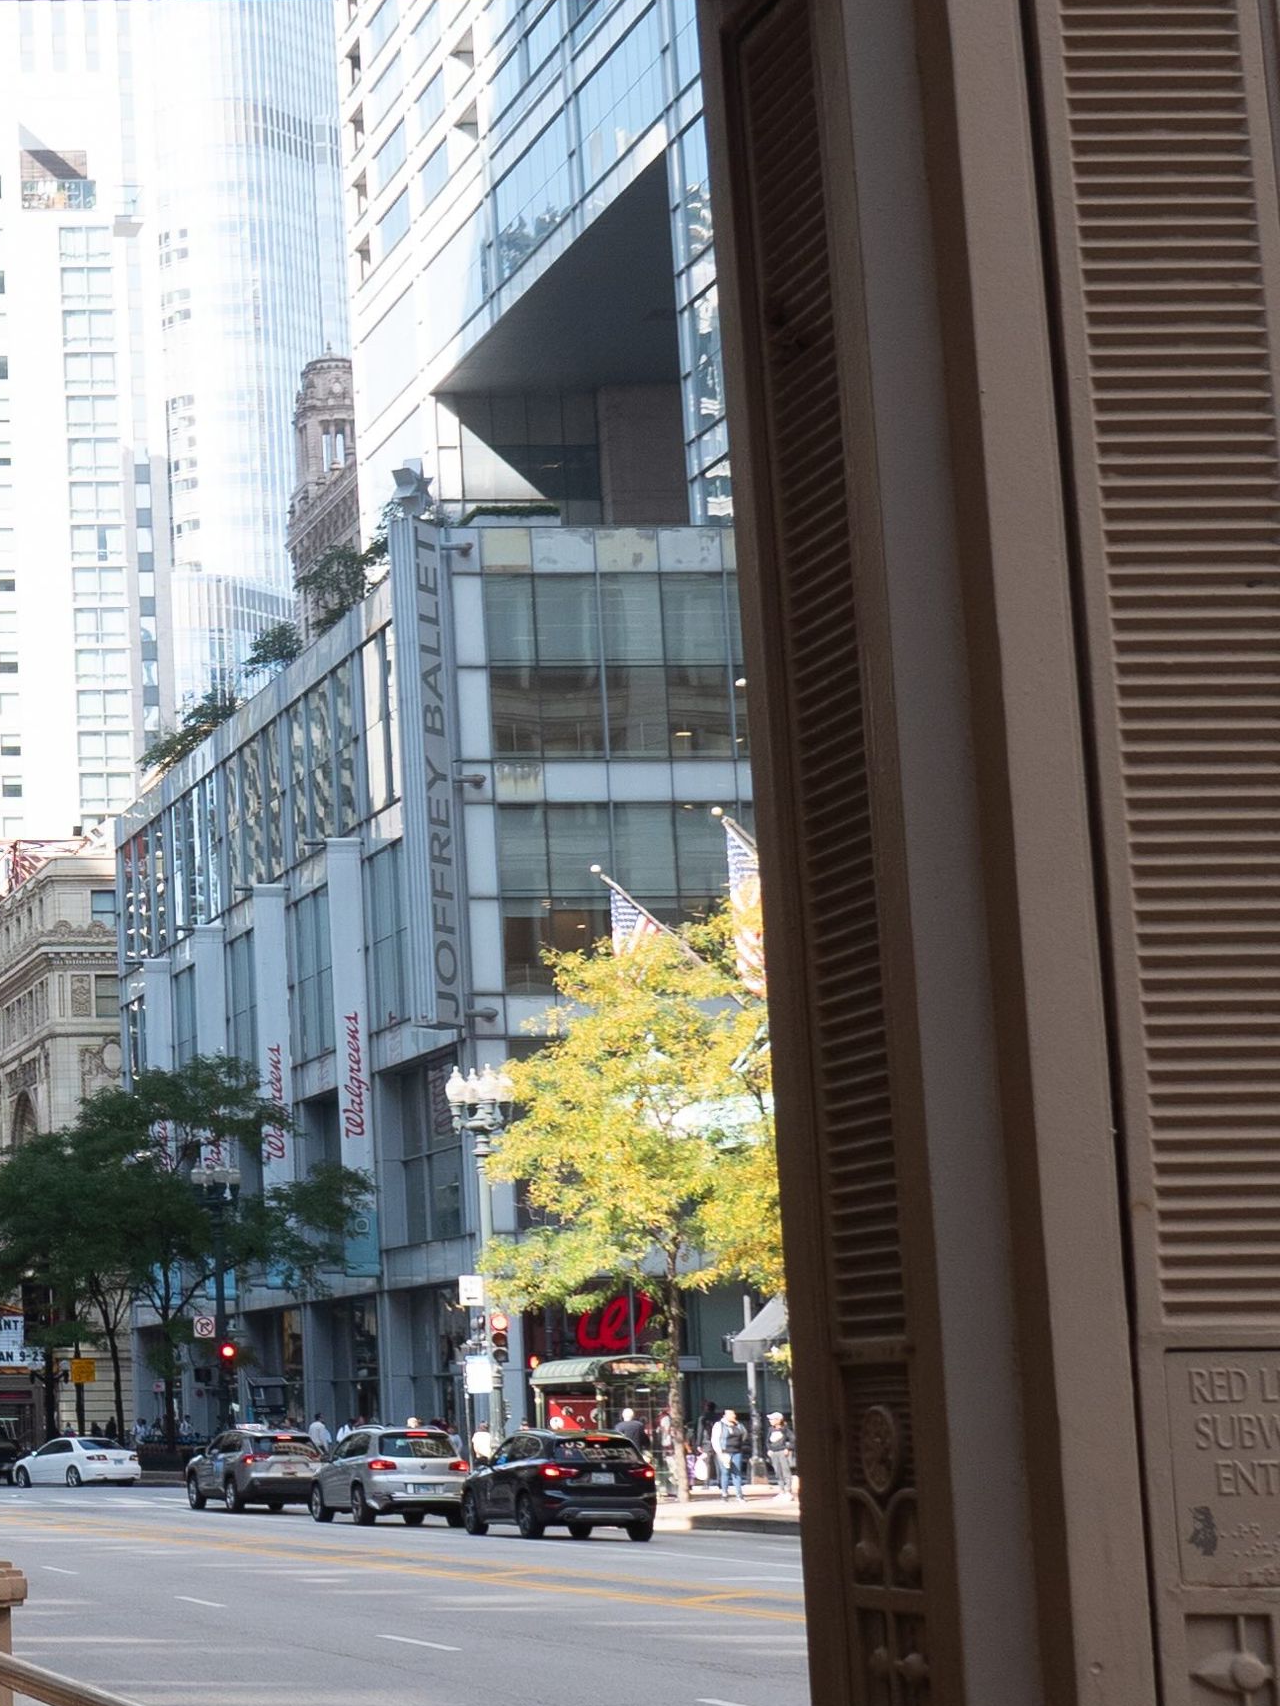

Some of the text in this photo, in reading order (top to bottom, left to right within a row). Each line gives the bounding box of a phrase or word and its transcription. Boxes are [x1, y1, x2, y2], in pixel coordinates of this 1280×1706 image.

[414, 526, 460, 1019] JOFFREY BALLET
[343, 1011, 371, 1139] Walgreens
[1189, 1368, 1248, 1404] RED
